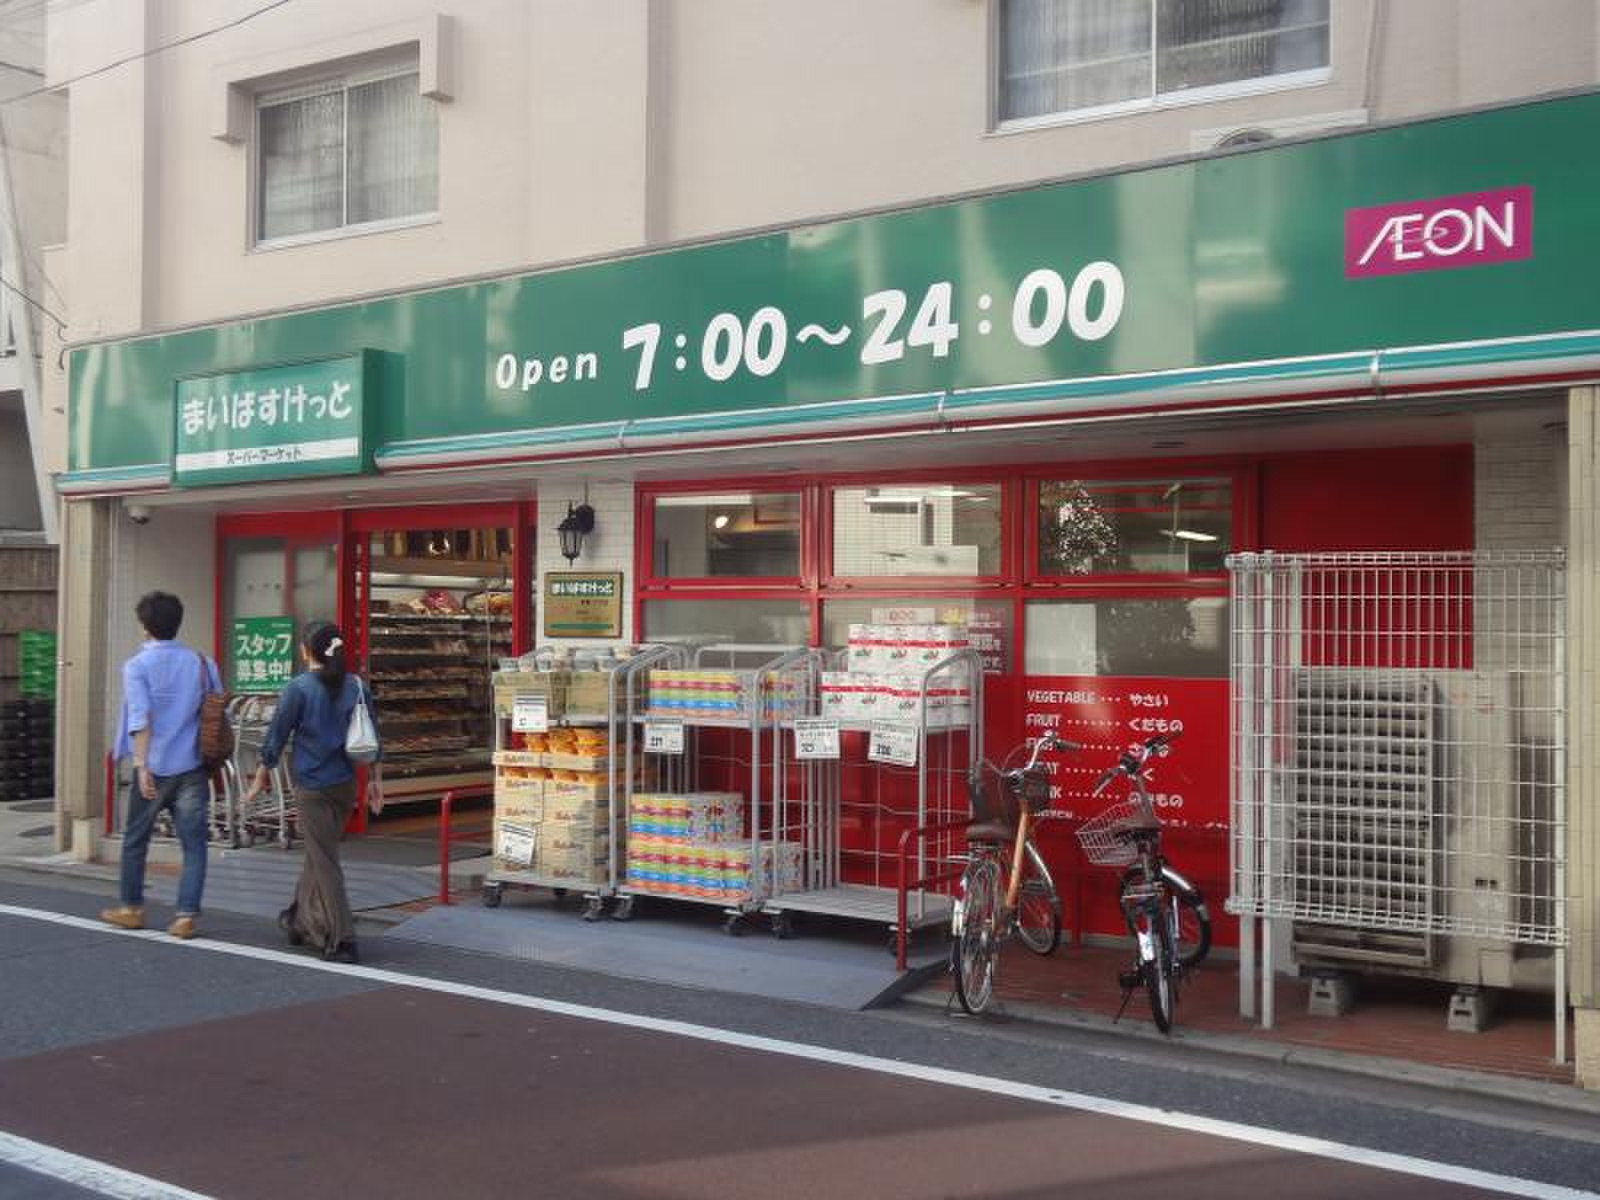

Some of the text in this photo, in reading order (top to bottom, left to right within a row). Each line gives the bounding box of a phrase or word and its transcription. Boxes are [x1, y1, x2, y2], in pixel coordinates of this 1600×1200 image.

[496, 352, 597, 391] Open
[183, 382, 353, 435] まいばすけっと
[226, 448, 302, 465] スーパーマーケット
[237, 633, 291, 656] スタッフ
[1027, 691, 1096, 705] VEGETABLE
[1128, 693, 1169, 707] やさい
[1025, 713, 1062, 727] FRUIT
[1127, 718, 1184, 732] くだもの
